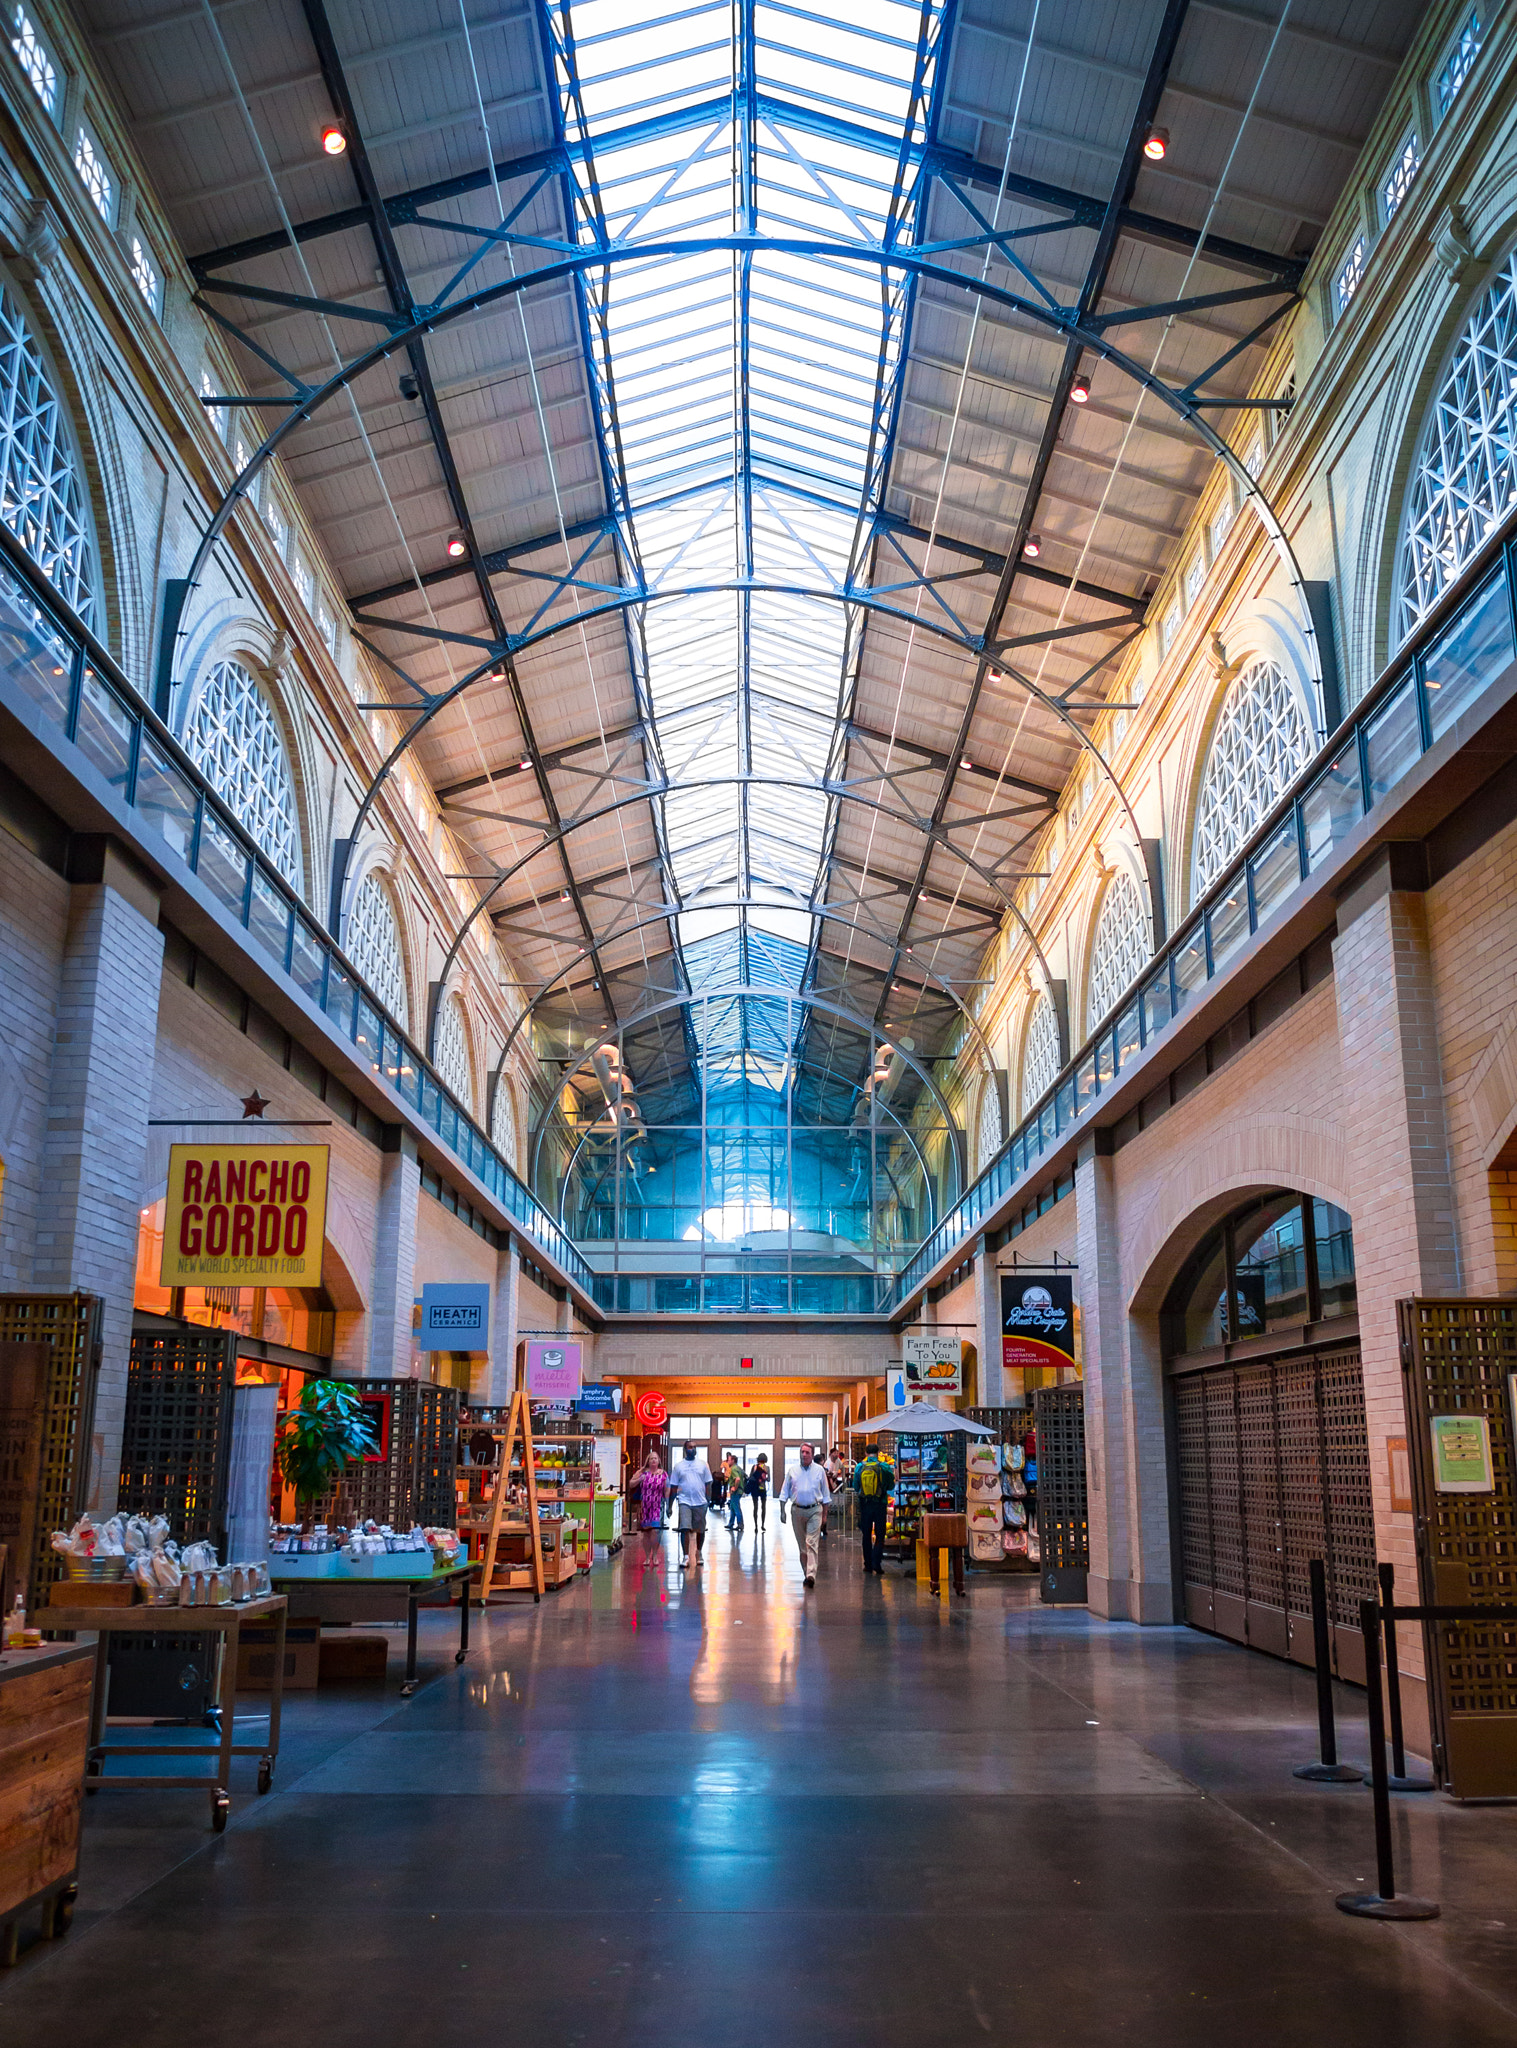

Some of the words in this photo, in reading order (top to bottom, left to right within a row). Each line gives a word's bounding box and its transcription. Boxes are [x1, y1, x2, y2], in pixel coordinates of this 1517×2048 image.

[183, 1159, 311, 1203] RANCHO
[179, 1204, 308, 1257] GORDO
[177, 1258, 198, 1273] NEW
[199, 1258, 230, 1273] WORLD
[232, 1258, 279, 1274] SPECIALTY
[281, 1258, 306, 1274] FOOD
[433, 1309, 478, 1318] HEATH
[1043, 1306, 1066, 1317] Gate
[1006, 1314, 1033, 1327] Meat
[1032, 1315, 1068, 1333] Company
[907, 1339, 930, 1349] Farm
[932, 1339, 958, 1349] Fresh
[915, 1350, 929, 1360] To
[931, 1350, 951, 1360] You
[635, 1391, 667, 1427] G
